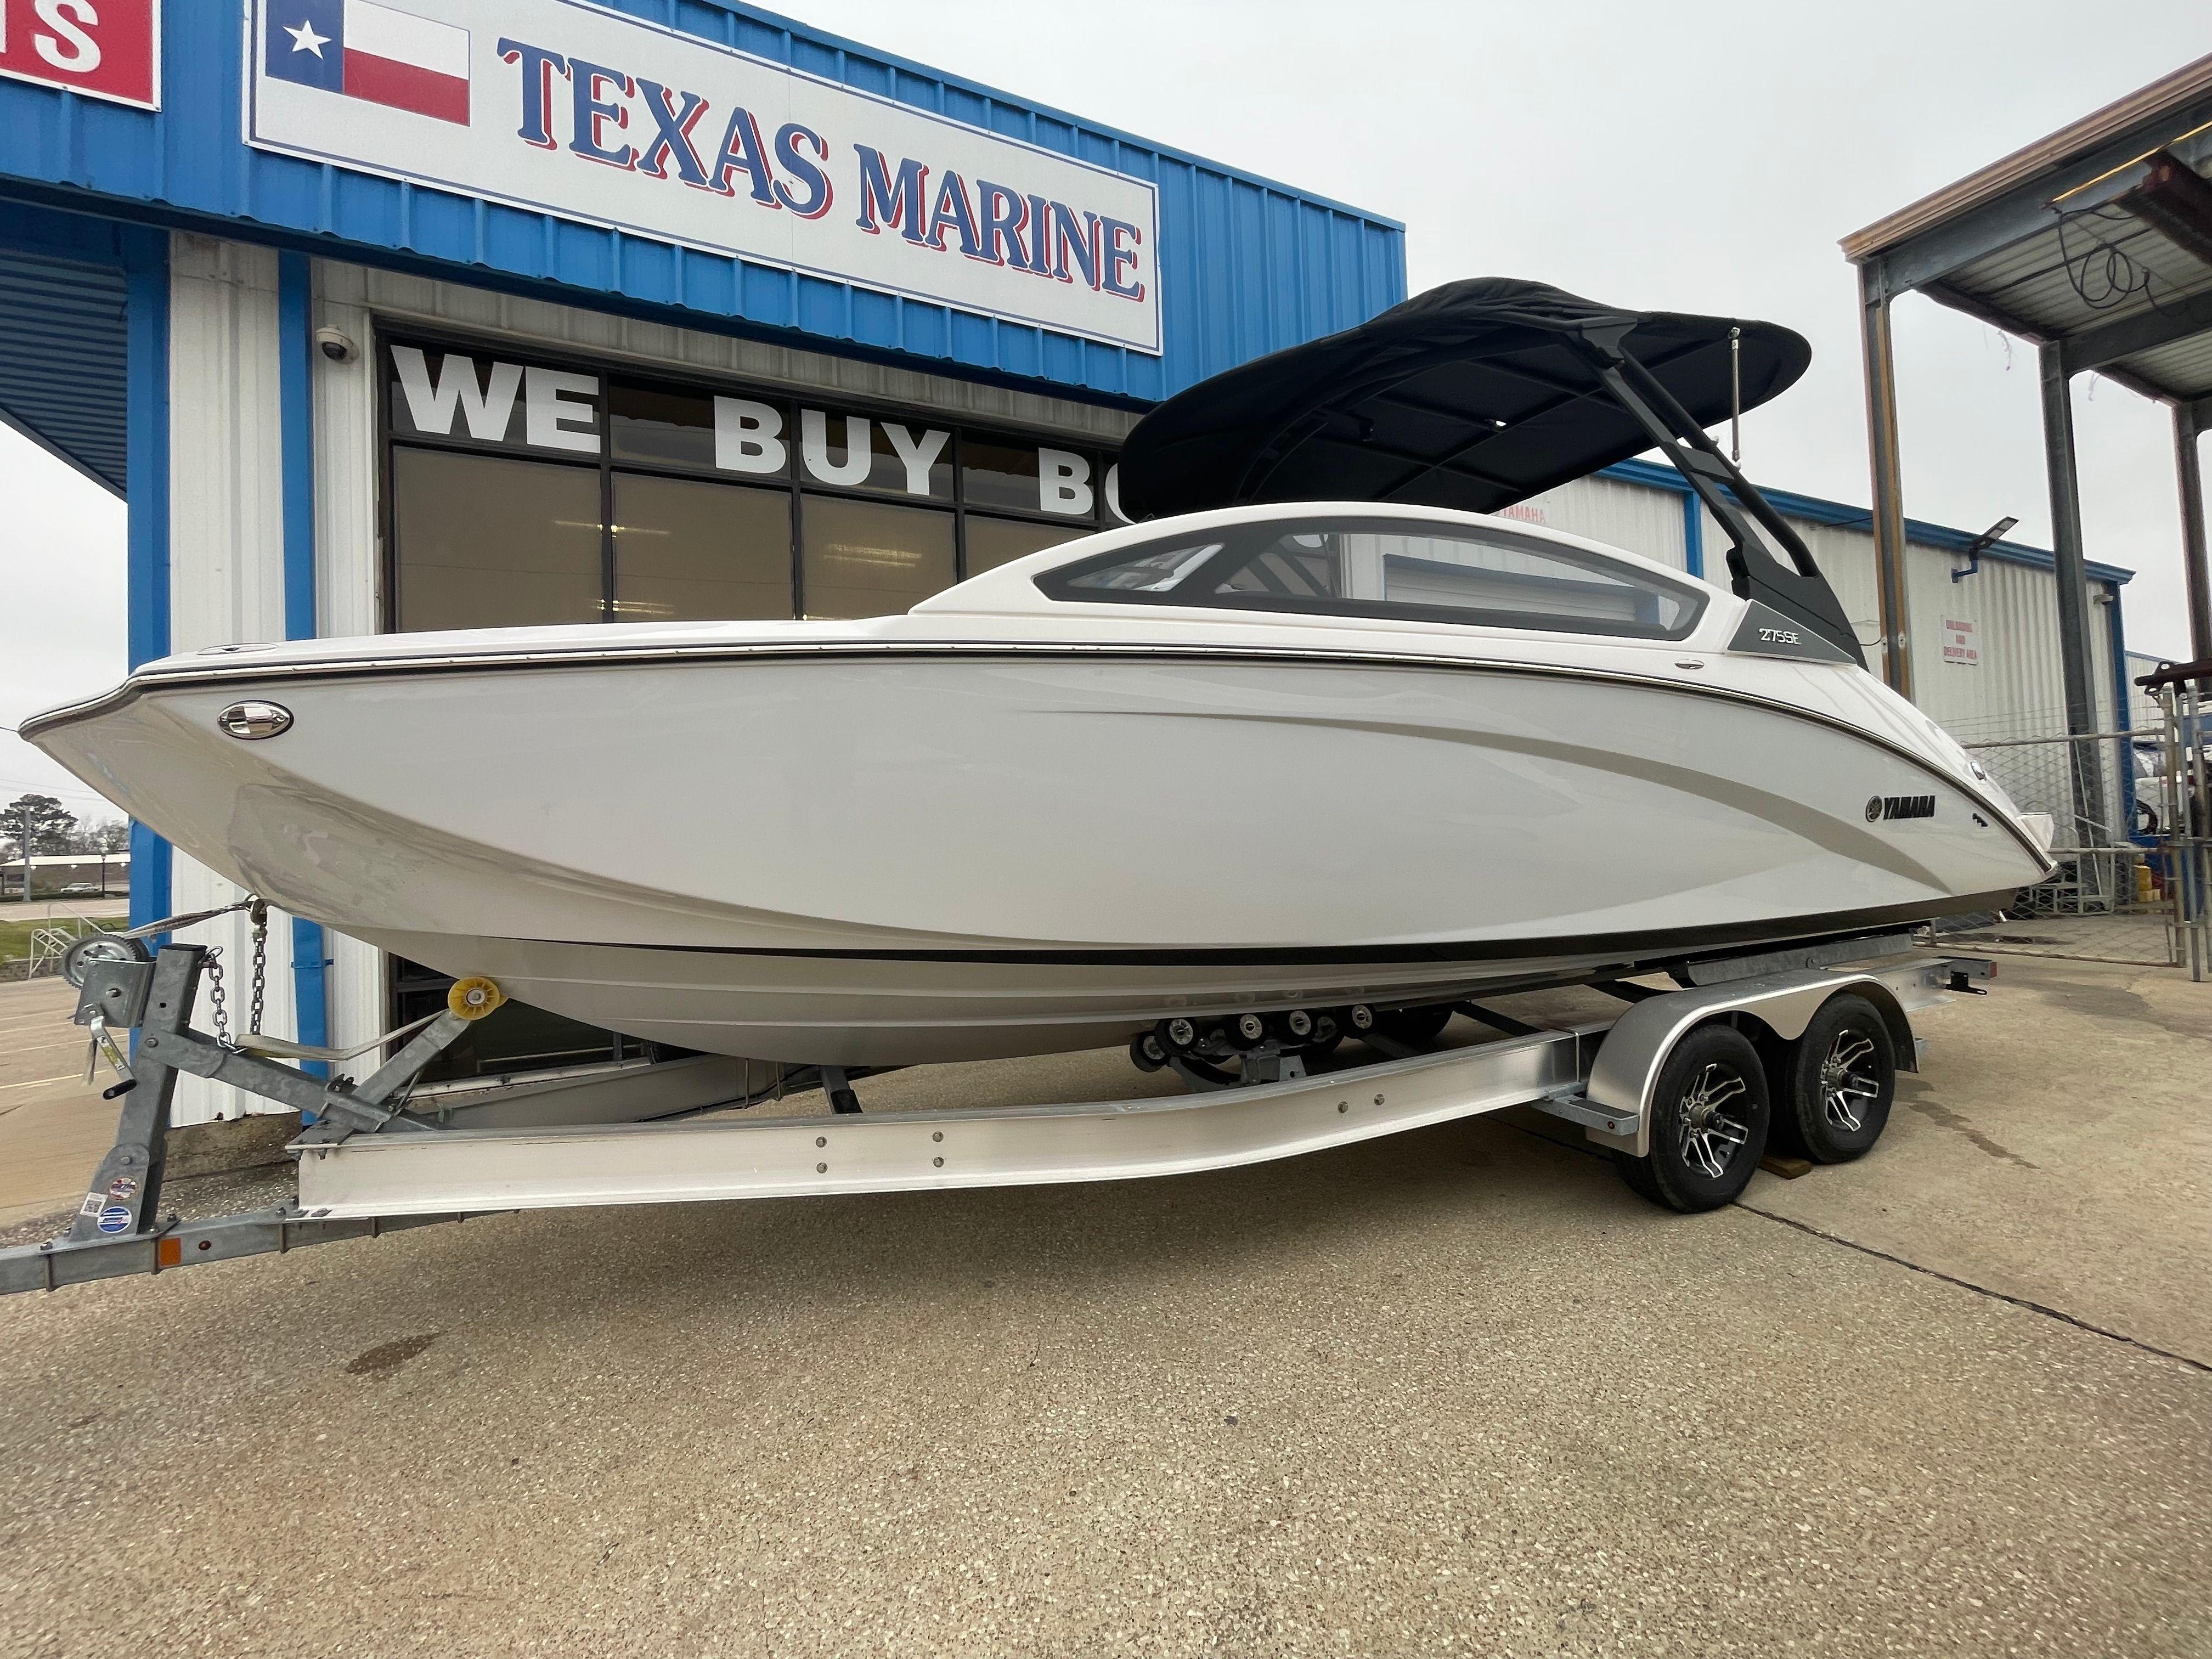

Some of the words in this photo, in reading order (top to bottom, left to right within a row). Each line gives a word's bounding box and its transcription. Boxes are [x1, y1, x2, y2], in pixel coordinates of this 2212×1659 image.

[0, 0, 101, 73] S
[496, 37, 833, 219] TEXAS
[853, 143, 1146, 303] MARINE
[390, 345, 601, 454] WE
[714, 395, 951, 496] BUY
[1038, 447, 1137, 524] B
[1759, 628, 1802, 645] 275SE
[1883, 795, 1936, 820] YAMAHA
